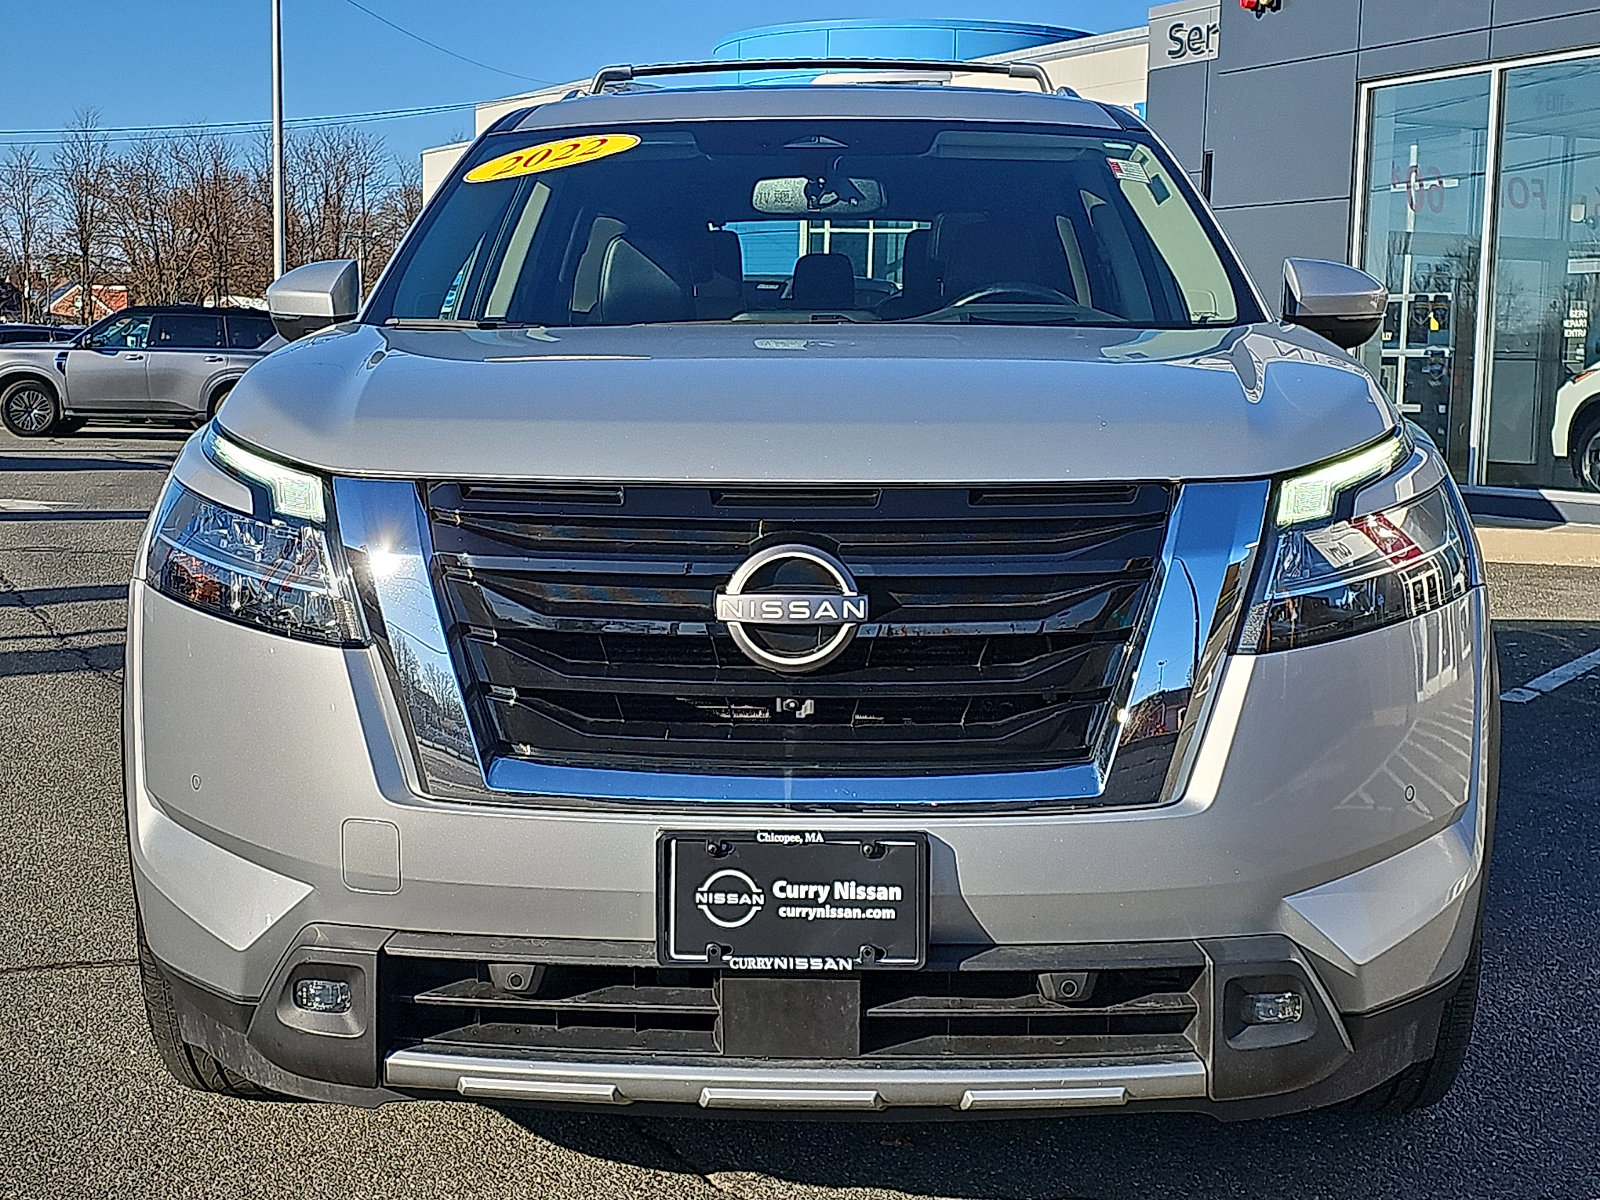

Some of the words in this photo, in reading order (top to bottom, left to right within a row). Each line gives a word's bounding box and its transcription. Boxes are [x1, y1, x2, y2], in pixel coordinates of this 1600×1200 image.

[491, 138, 608, 177] 2022
[721, 599, 866, 620] NISSAN
[804, 831, 824, 843] MA
[695, 892, 764, 905] NISSAN
[772, 880, 829, 903] Curry
[834, 881, 902, 901] Nissan
[778, 905, 896, 921] currynissan.com
